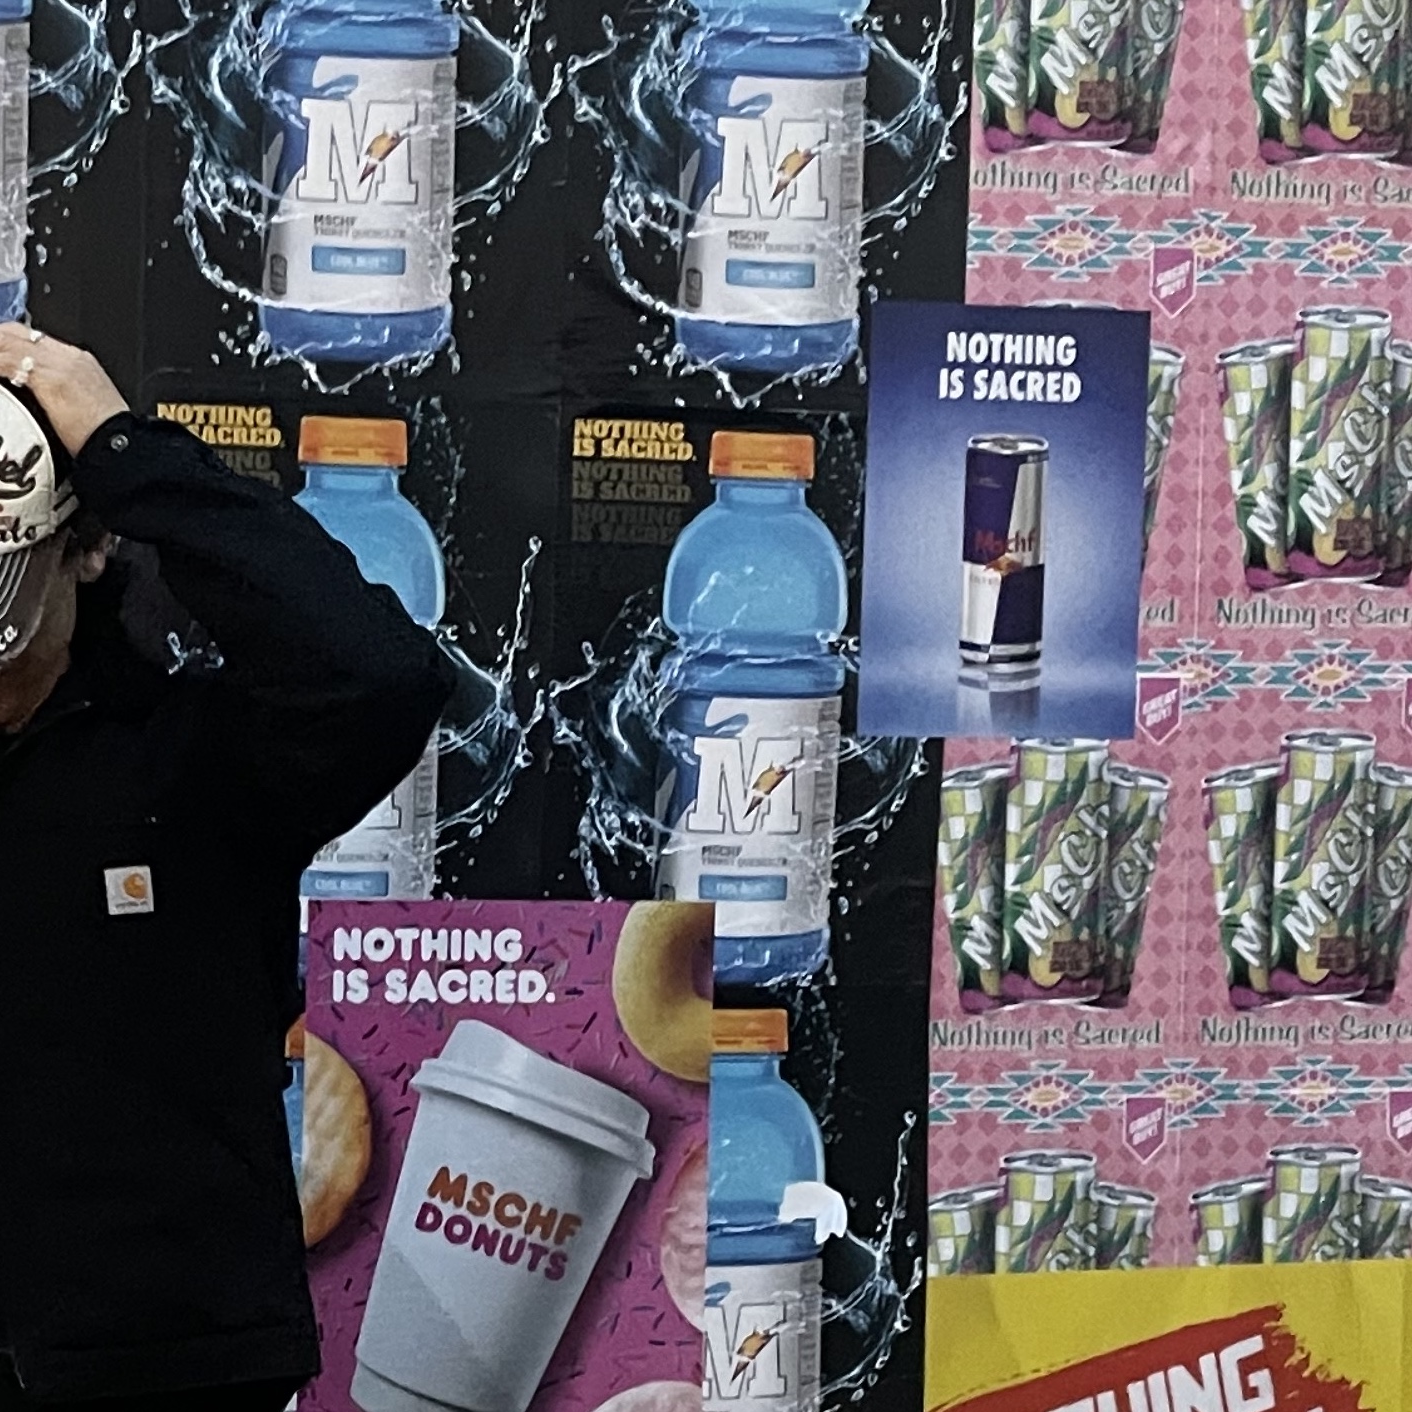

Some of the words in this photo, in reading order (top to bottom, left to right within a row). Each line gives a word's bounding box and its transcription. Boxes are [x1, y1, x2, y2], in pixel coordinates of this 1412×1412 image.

[973, 161, 1057, 195] othing
[1070, 170, 1091, 188] is
[1096, 164, 1190, 194] Sacred
[1231, 169, 1331, 206] Nothing
[1344, 182, 1362, 199] is
[314, 214, 358, 227] MSCHF
[727, 230, 770, 242] MSCHF
[946, 331, 1078, 366] NOTHING
[939, 368, 964, 398] IS
[973, 369, 1082, 403] SACRED
[157, 403, 272, 427] NOTHING
[574, 419, 685, 442] NOTHING
[573, 438, 595, 457] IS
[601, 438, 697, 461] SACRED.
[573, 461, 684, 484] NOTHING
[572, 480, 594, 499] IS
[1217, 597, 1316, 628] Nothing
[1327, 606, 1346, 625] is
[333, 928, 523, 963] NOTHING
[333, 969, 369, 1003] IS
[385, 969, 555, 1004] SACRED.
[929, 1022, 1031, 1050] Nothing
[1044, 1026, 1064, 1045] is
[1074, 1019, 1160, 1045] Sacred
[1201, 1016, 1299, 1046] Nothing
[1310, 1021, 1329, 1040] is
[427, 1166, 582, 1245] MSCHF
[415, 1201, 568, 1281] DONUTS
